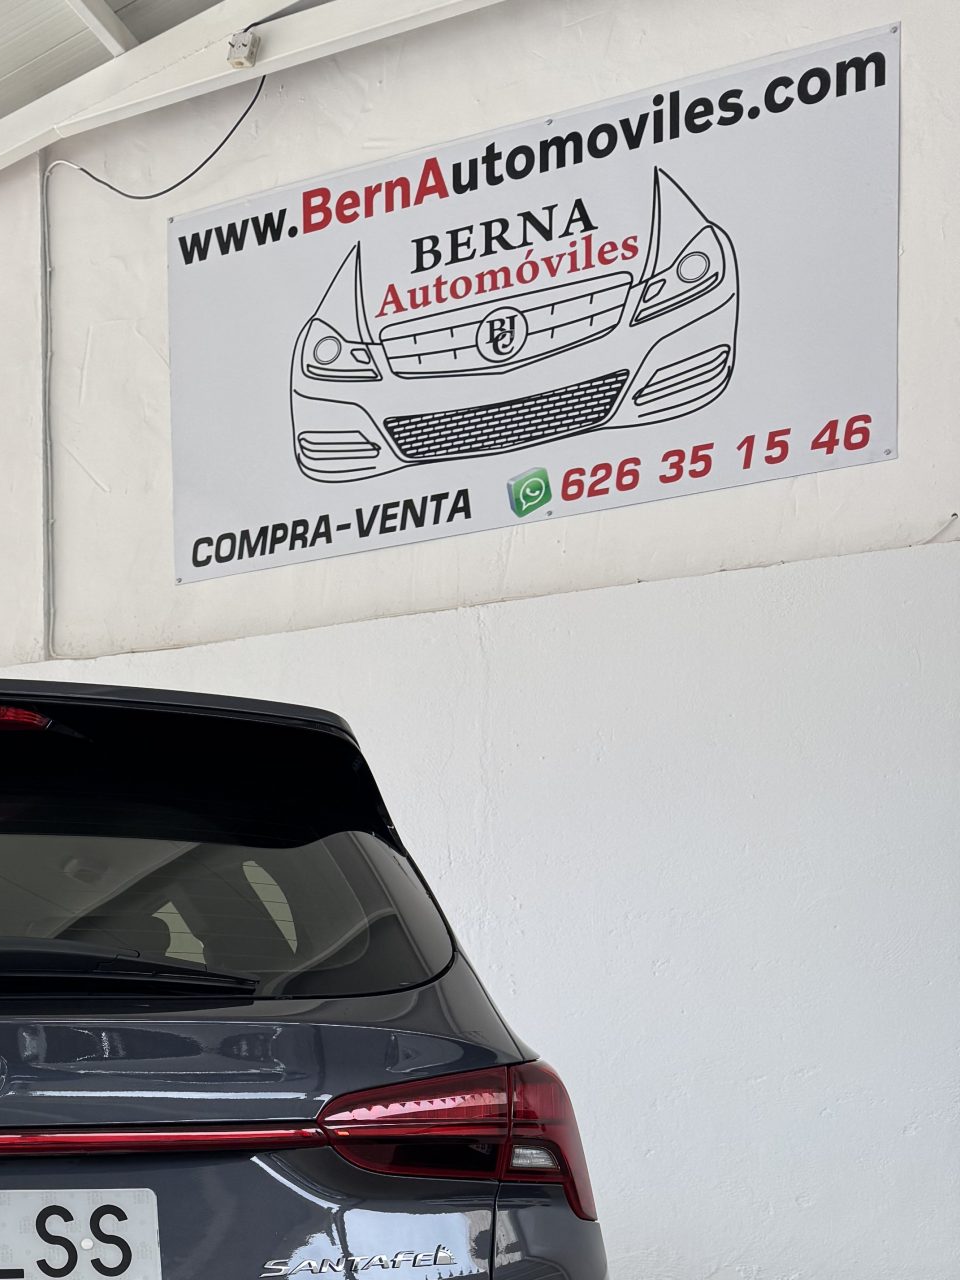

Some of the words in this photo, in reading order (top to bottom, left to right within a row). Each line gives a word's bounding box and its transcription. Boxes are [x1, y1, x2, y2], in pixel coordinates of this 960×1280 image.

[178, 50, 888, 266] www.BernAutomoviles.com
[375, 231, 640, 319] Automóviles
[410, 198, 598, 275] BERNA
[560, 458, 641, 502] 626
[659, 442, 714, 482] 35
[734, 428, 790, 470] 15
[810, 413, 872, 456] 46
[191, 488, 472, 569] COMPRA-VENTA
